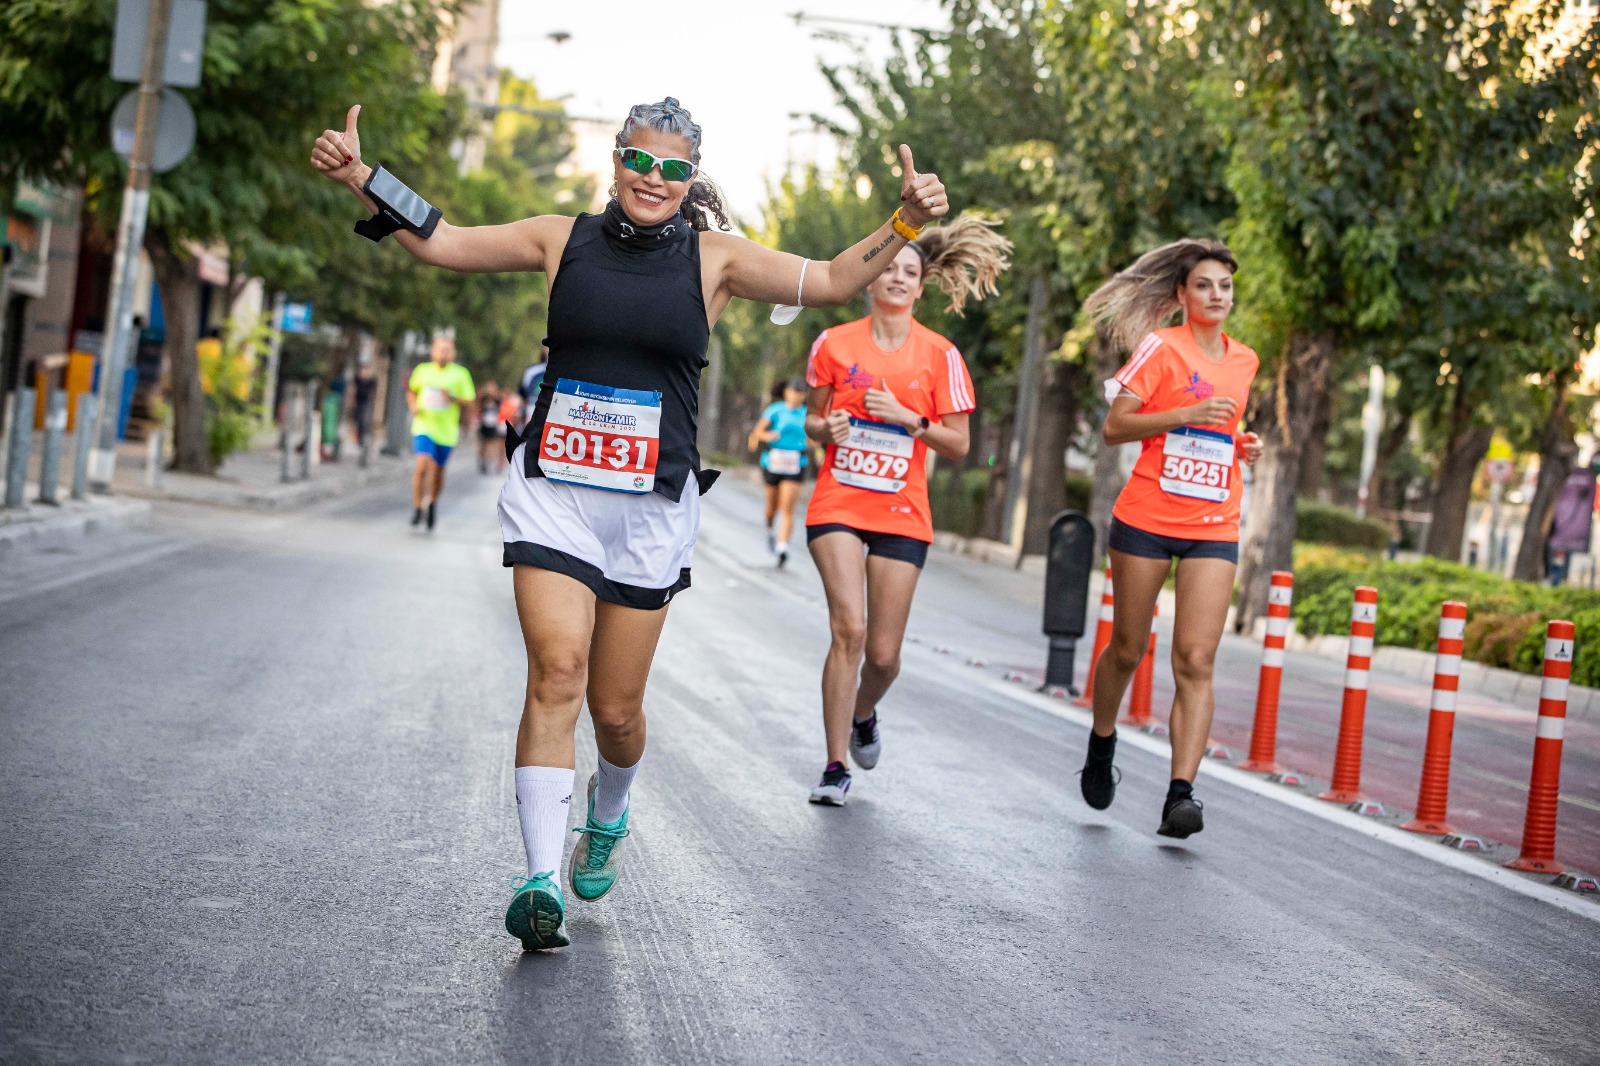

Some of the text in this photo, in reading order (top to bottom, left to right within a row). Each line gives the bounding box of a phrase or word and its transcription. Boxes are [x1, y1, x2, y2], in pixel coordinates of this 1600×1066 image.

[544, 427, 648, 470] 50131
[834, 447, 909, 480] 50679
[1163, 456, 1229, 488] 50251
